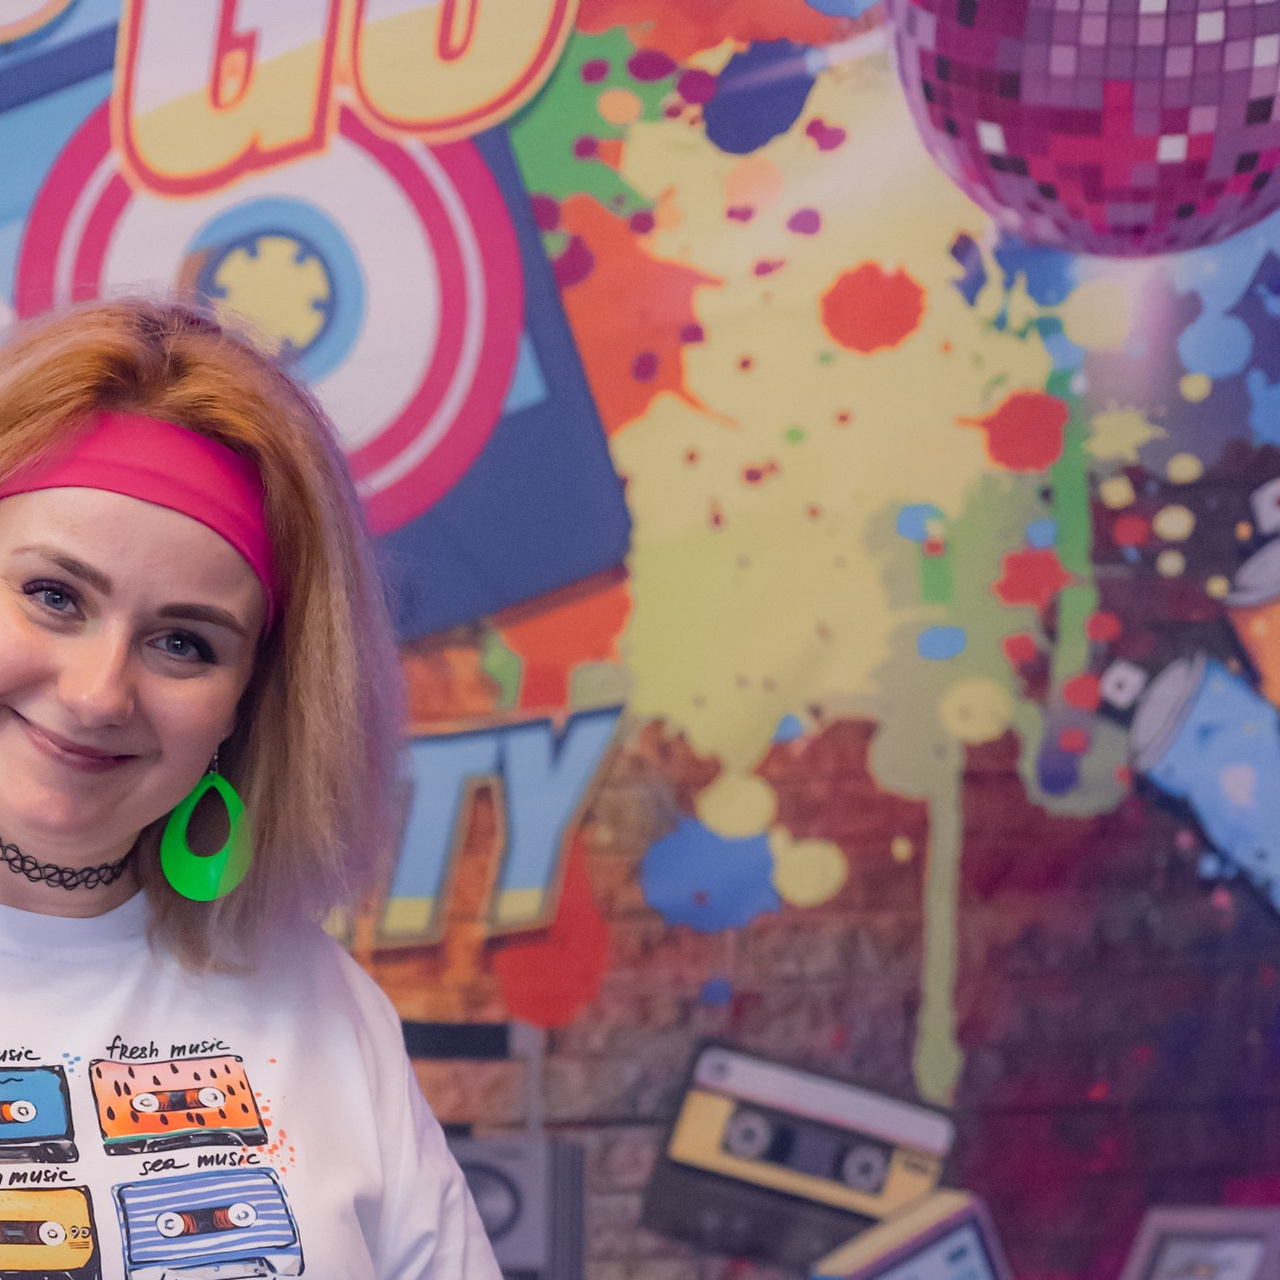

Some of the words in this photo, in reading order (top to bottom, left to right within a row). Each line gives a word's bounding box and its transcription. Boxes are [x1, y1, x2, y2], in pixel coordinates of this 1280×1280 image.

[169, 1036, 231, 1059] music
[138, 1156, 190, 1177] sea
[196, 1151, 262, 1169] music
[8, 1166, 76, 1186] music
